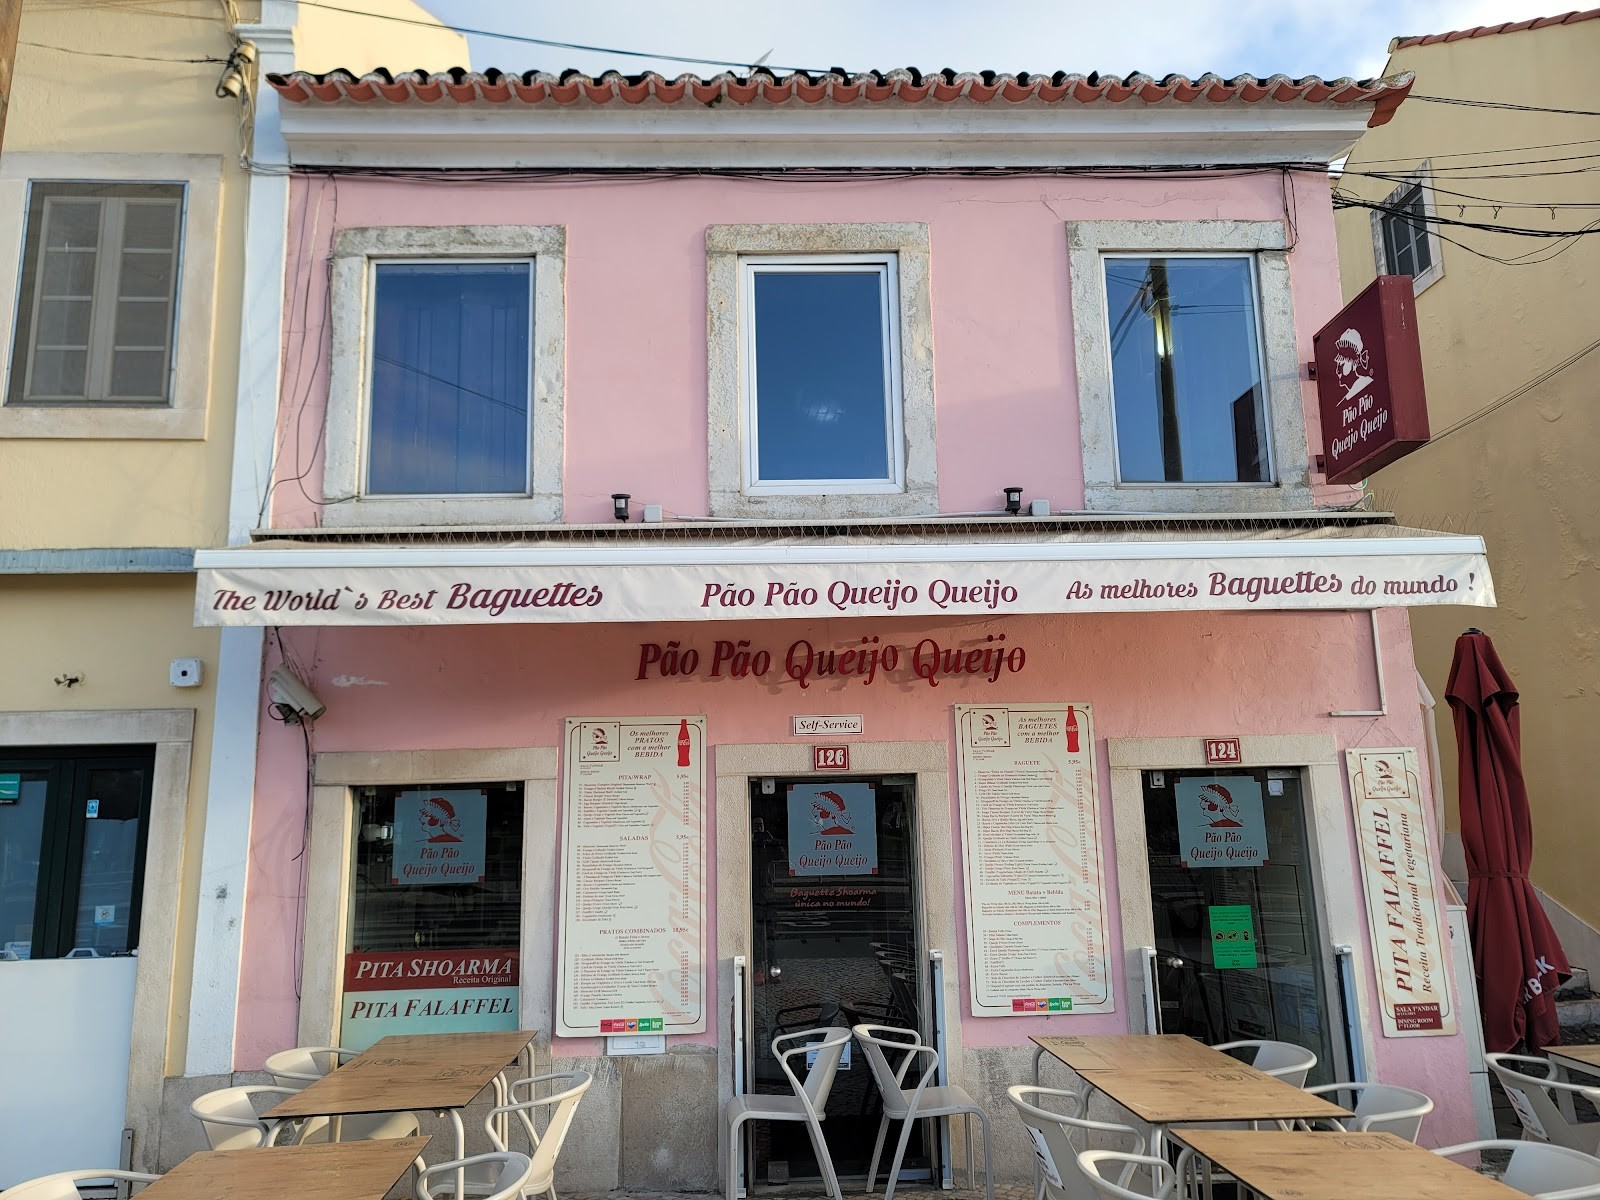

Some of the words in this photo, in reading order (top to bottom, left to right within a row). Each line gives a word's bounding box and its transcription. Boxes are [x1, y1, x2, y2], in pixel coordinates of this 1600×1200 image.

[1342, 406, 1358, 427] Pão
[1358, 394, 1374, 416] Pão
[1331, 428, 1358, 460] Queijo
[1360, 407, 1388, 441] Queijo
[700, 582, 755, 607] Pão
[764, 581, 818, 606] Pão
[827, 579, 918, 611] Queijo
[928, 579, 1018, 610] Queijo
[1066, 580, 1093, 600] As
[1100, 578, 1198, 600] melhores
[1208, 571, 1343, 603] Baguettes
[1350, 575, 1377, 596] do
[213, 589, 257, 611] The
[377, 589, 438, 610] Best
[446, 582, 603, 617] Baguettes
[634, 641, 698, 681] Pão
[708, 639, 771, 678] Pão
[785, 636, 899, 689] Queijo
[912, 634, 1026, 688] Queijo
[799, 720, 858, 731] Self-Service
[818, 749, 844, 767] 126
[1210, 742, 1236, 760] 124
[814, 839, 832, 851] Pão
[834, 839, 852, 850] Pão
[1205, 831, 1222, 843] Pão
[1224, 831, 1242, 843] Pão
[1400, 813, 1417, 879] Vegetariana
[420, 847, 438, 859] Pão
[441, 847, 460, 858] Pão
[799, 854, 832, 869] Queijo
[835, 854, 868, 868] Queijo
[1190, 846, 1223, 861] Queijo
[1226, 846, 1258, 860] Queijo
[403, 863, 437, 878] Queijo
[440, 862, 475, 877] Queijo
[1373, 807, 1404, 931] FALAFFEL
[790, 887, 835, 900] Baguette
[835, 886, 877, 897] Shoarma
[795, 899, 820, 908] única
[836, 897, 871, 907] mundo!
[1408, 882, 1425, 947] Tradicional
[354, 961, 403, 979] PITA
[407, 958, 512, 977] SHOARMA
[1391, 939, 1413, 993] PITA
[1419, 951, 1432, 993] Receita
[453, 976, 480, 984] Receita
[481, 975, 512, 985] Original
[349, 1001, 398, 1019] PITA
[403, 998, 513, 1017] FALAFFEL
